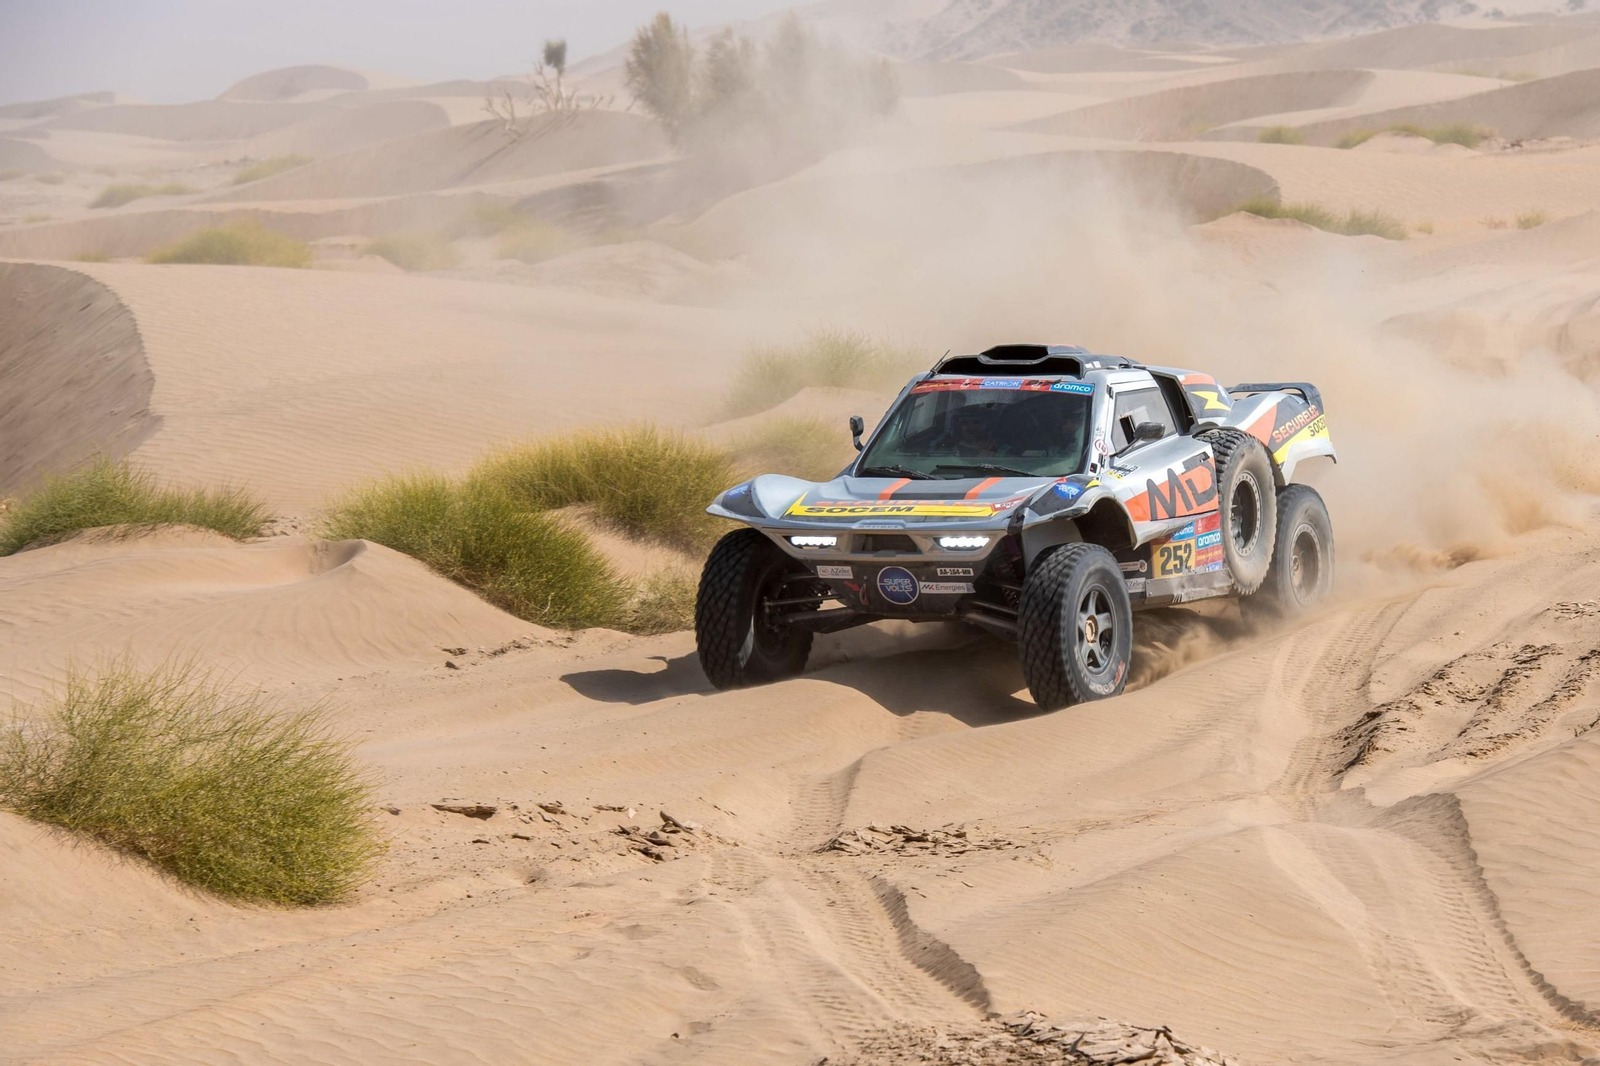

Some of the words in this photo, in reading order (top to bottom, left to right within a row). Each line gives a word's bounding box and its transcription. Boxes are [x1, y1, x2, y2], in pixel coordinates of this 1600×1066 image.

[1053, 383, 1091, 392] aramco
[804, 506, 915, 514] SOCEM
[1198, 532, 1221, 547] aramco
[1160, 542, 1193, 576] 252
[884, 578, 912, 587] SUPER
[935, 584, 966, 592] Energies
